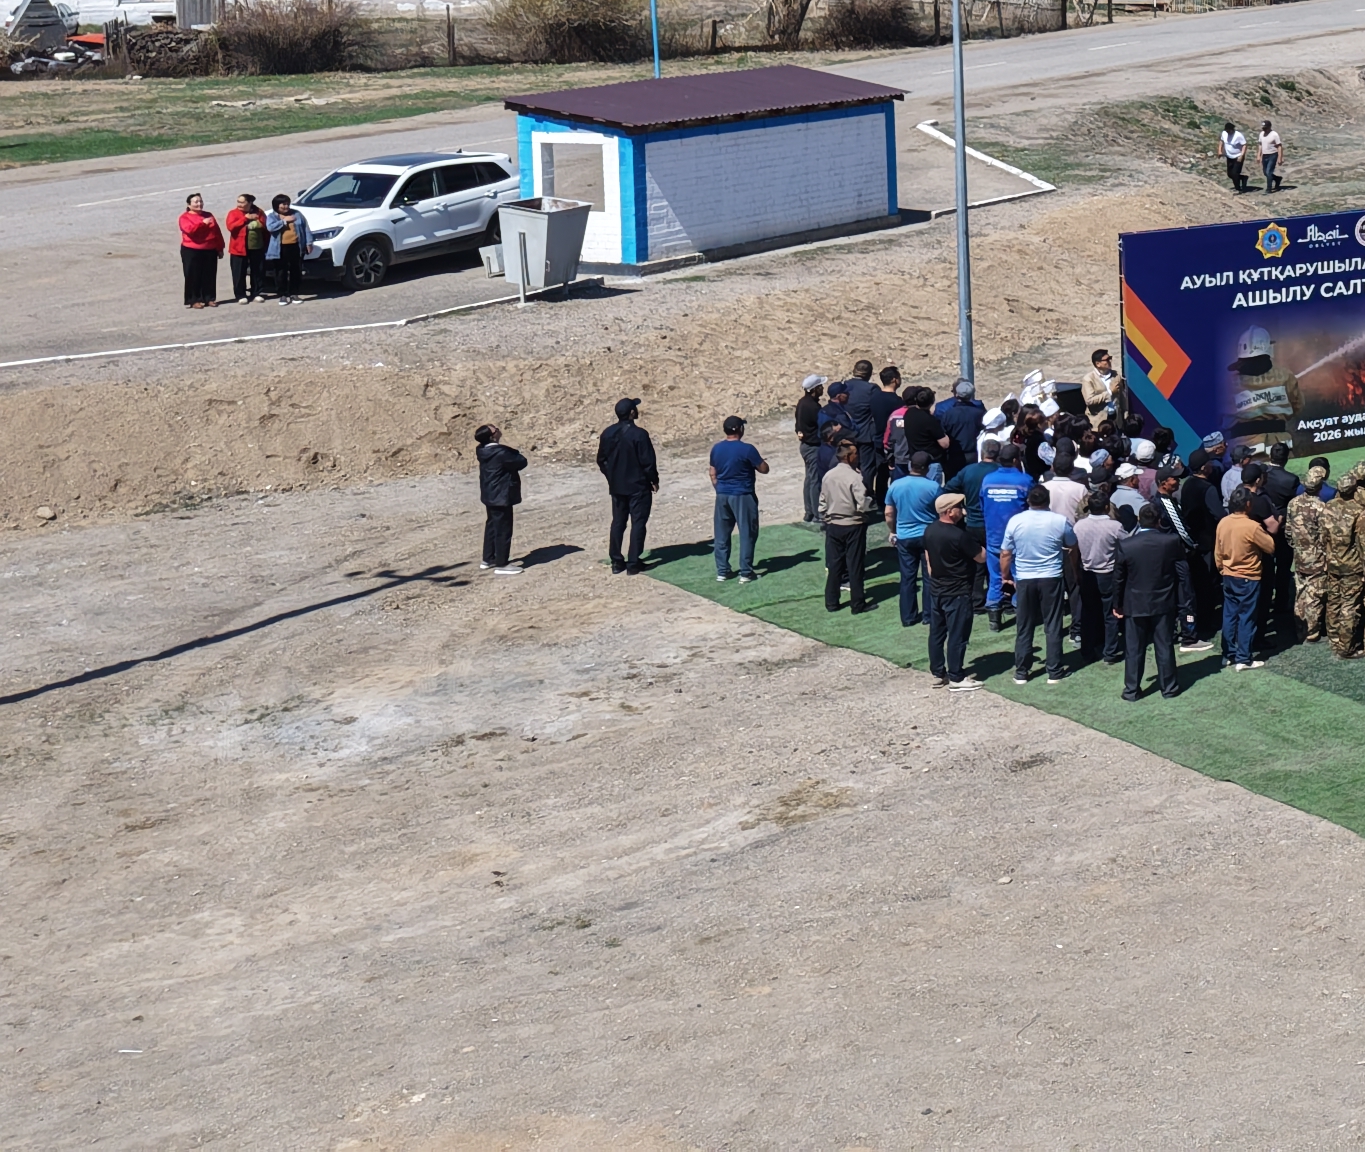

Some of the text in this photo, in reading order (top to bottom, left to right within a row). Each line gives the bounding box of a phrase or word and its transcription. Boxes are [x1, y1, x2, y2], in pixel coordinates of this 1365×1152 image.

[1297, 223, 1349, 242] Abai
[1180, 271, 1233, 290] АУЫЛ
[1232, 284, 1315, 309] АШЫЛУ
[1297, 415, 1340, 431] Ақсуат
[1313, 429, 1342, 443] 2026
